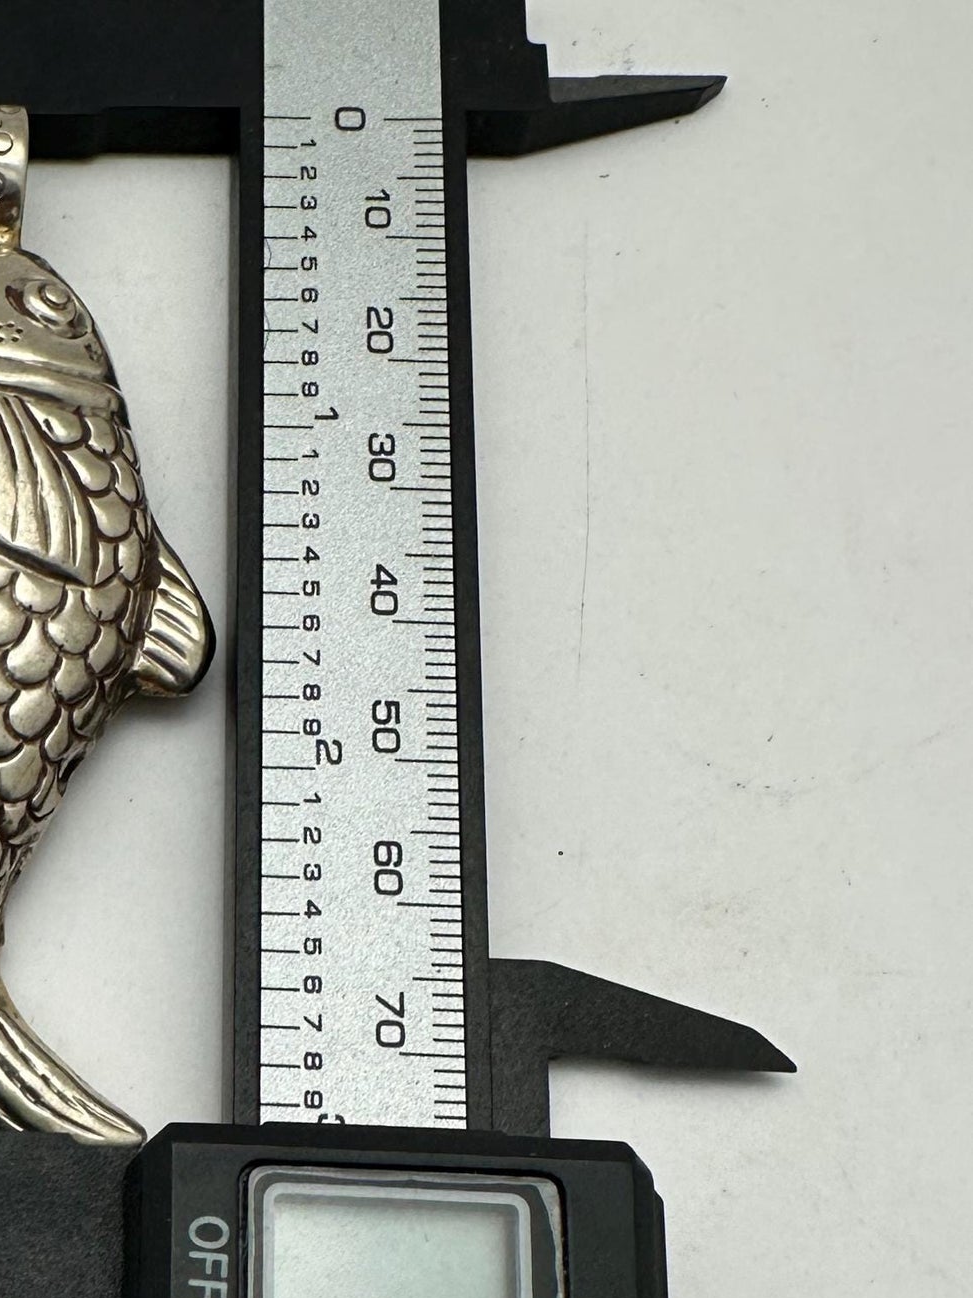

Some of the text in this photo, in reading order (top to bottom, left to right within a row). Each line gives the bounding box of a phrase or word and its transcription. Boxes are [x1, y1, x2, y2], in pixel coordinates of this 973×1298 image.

[299, 165, 318, 181] 2
[299, 194, 318, 211] 3
[300, 225, 318, 243] 4
[300, 255, 319, 272] 5
[299, 287, 320, 304] 6
[301, 316, 320, 335] 7
[300, 349, 320, 367] 8
[314, 406, 339, 420] 1
[301, 478, 322, 498] 2
[300, 512, 321, 531] 3
[302, 545, 321, 565] 4
[334, 107, 405, 1048] 0 10 20 30 40 50 60 70
[300, 579, 321, 598] 5
[302, 613, 321, 633] 6
[301, 648, 322, 667] 7
[301, 682, 322, 702] 8
[315, 739, 343, 766] 2
[302, 825, 322, 847] 2
[302, 862, 323, 882] 3
[303, 898, 323, 920] 4
[302, 936, 323, 956] 5
[302, 974, 324, 995] 6
[302, 1013, 323, 1033] 7
[302, 1051, 325, 1072] 8
[303, 1089, 324, 1110] 9
